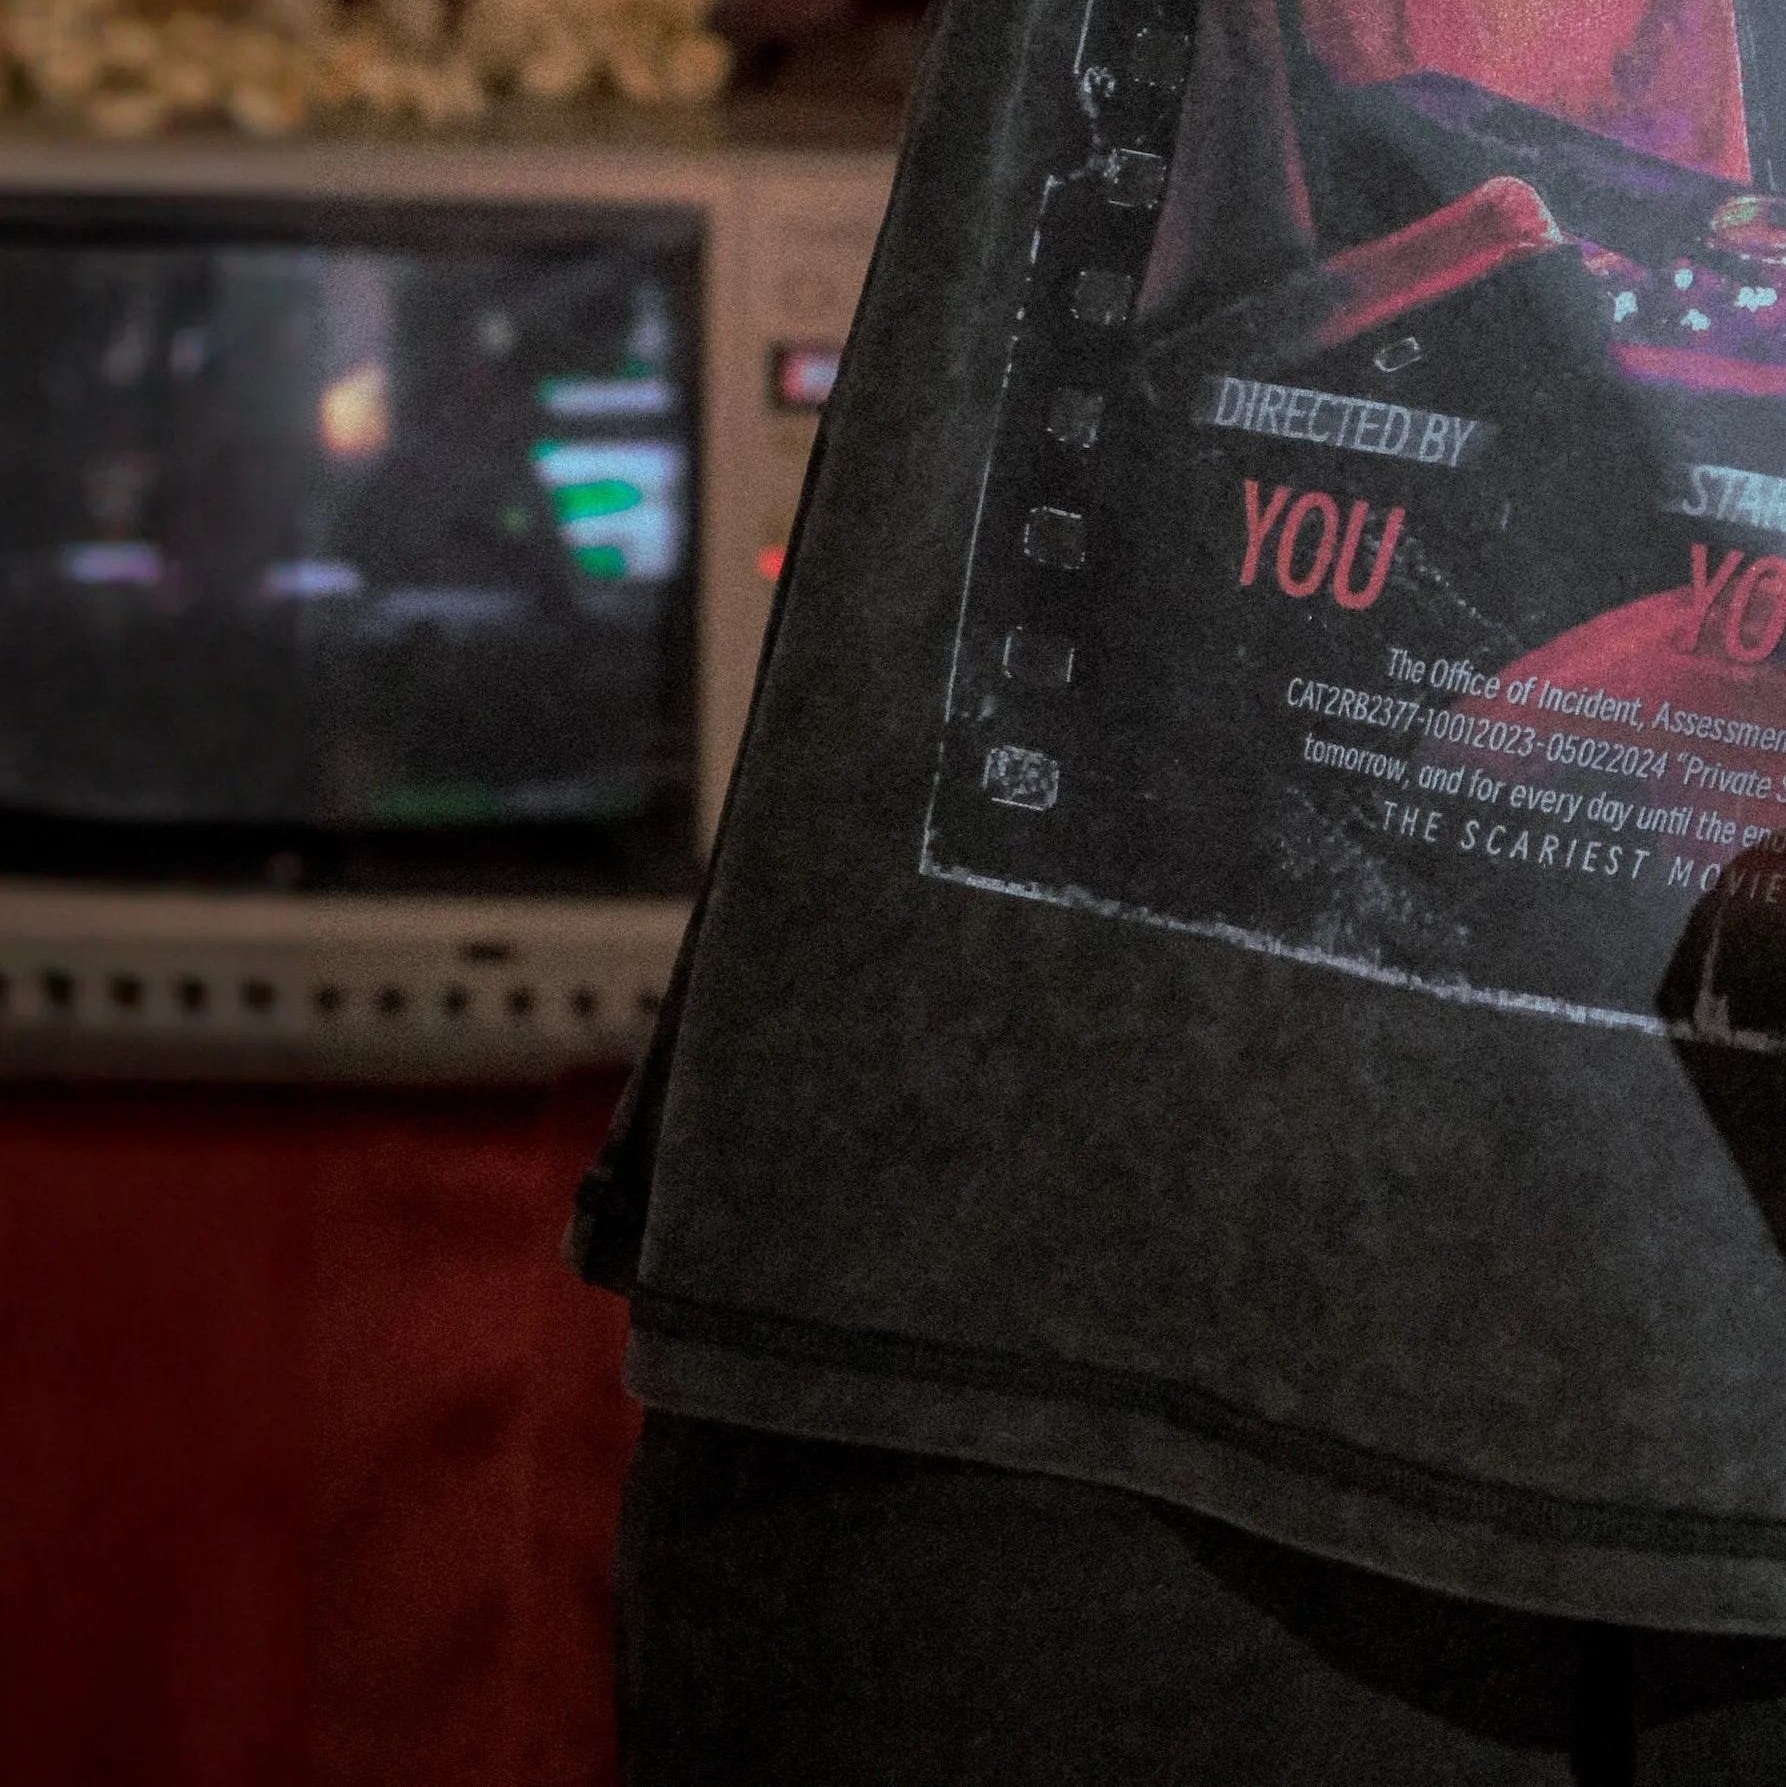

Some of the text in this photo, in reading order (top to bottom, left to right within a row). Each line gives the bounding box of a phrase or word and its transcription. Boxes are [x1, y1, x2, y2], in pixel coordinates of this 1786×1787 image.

[1214, 376, 1478, 467] DIRECTED BY
[1239, 478, 1406, 611] YOU
[1386, 647, 1427, 684] The
[1430, 658, 1501, 700] Office
[1507, 676, 1538, 707] of
[1539, 680, 1645, 731] Incident,
[1304, 732, 1409, 791] tomorrow,
[1419, 764, 1464, 797] and
[1467, 768, 1504, 803] for
[1511, 784, 1583, 824] every
[1588, 791, 1633, 832] day
[1637, 805, 1693, 837] until
[1698, 811, 1737, 845] the
[1382, 800, 1443, 844] THE
[1460, 819, 1650, 880] SCARIEST
[1667, 856, 1786, 905] MOVIE
